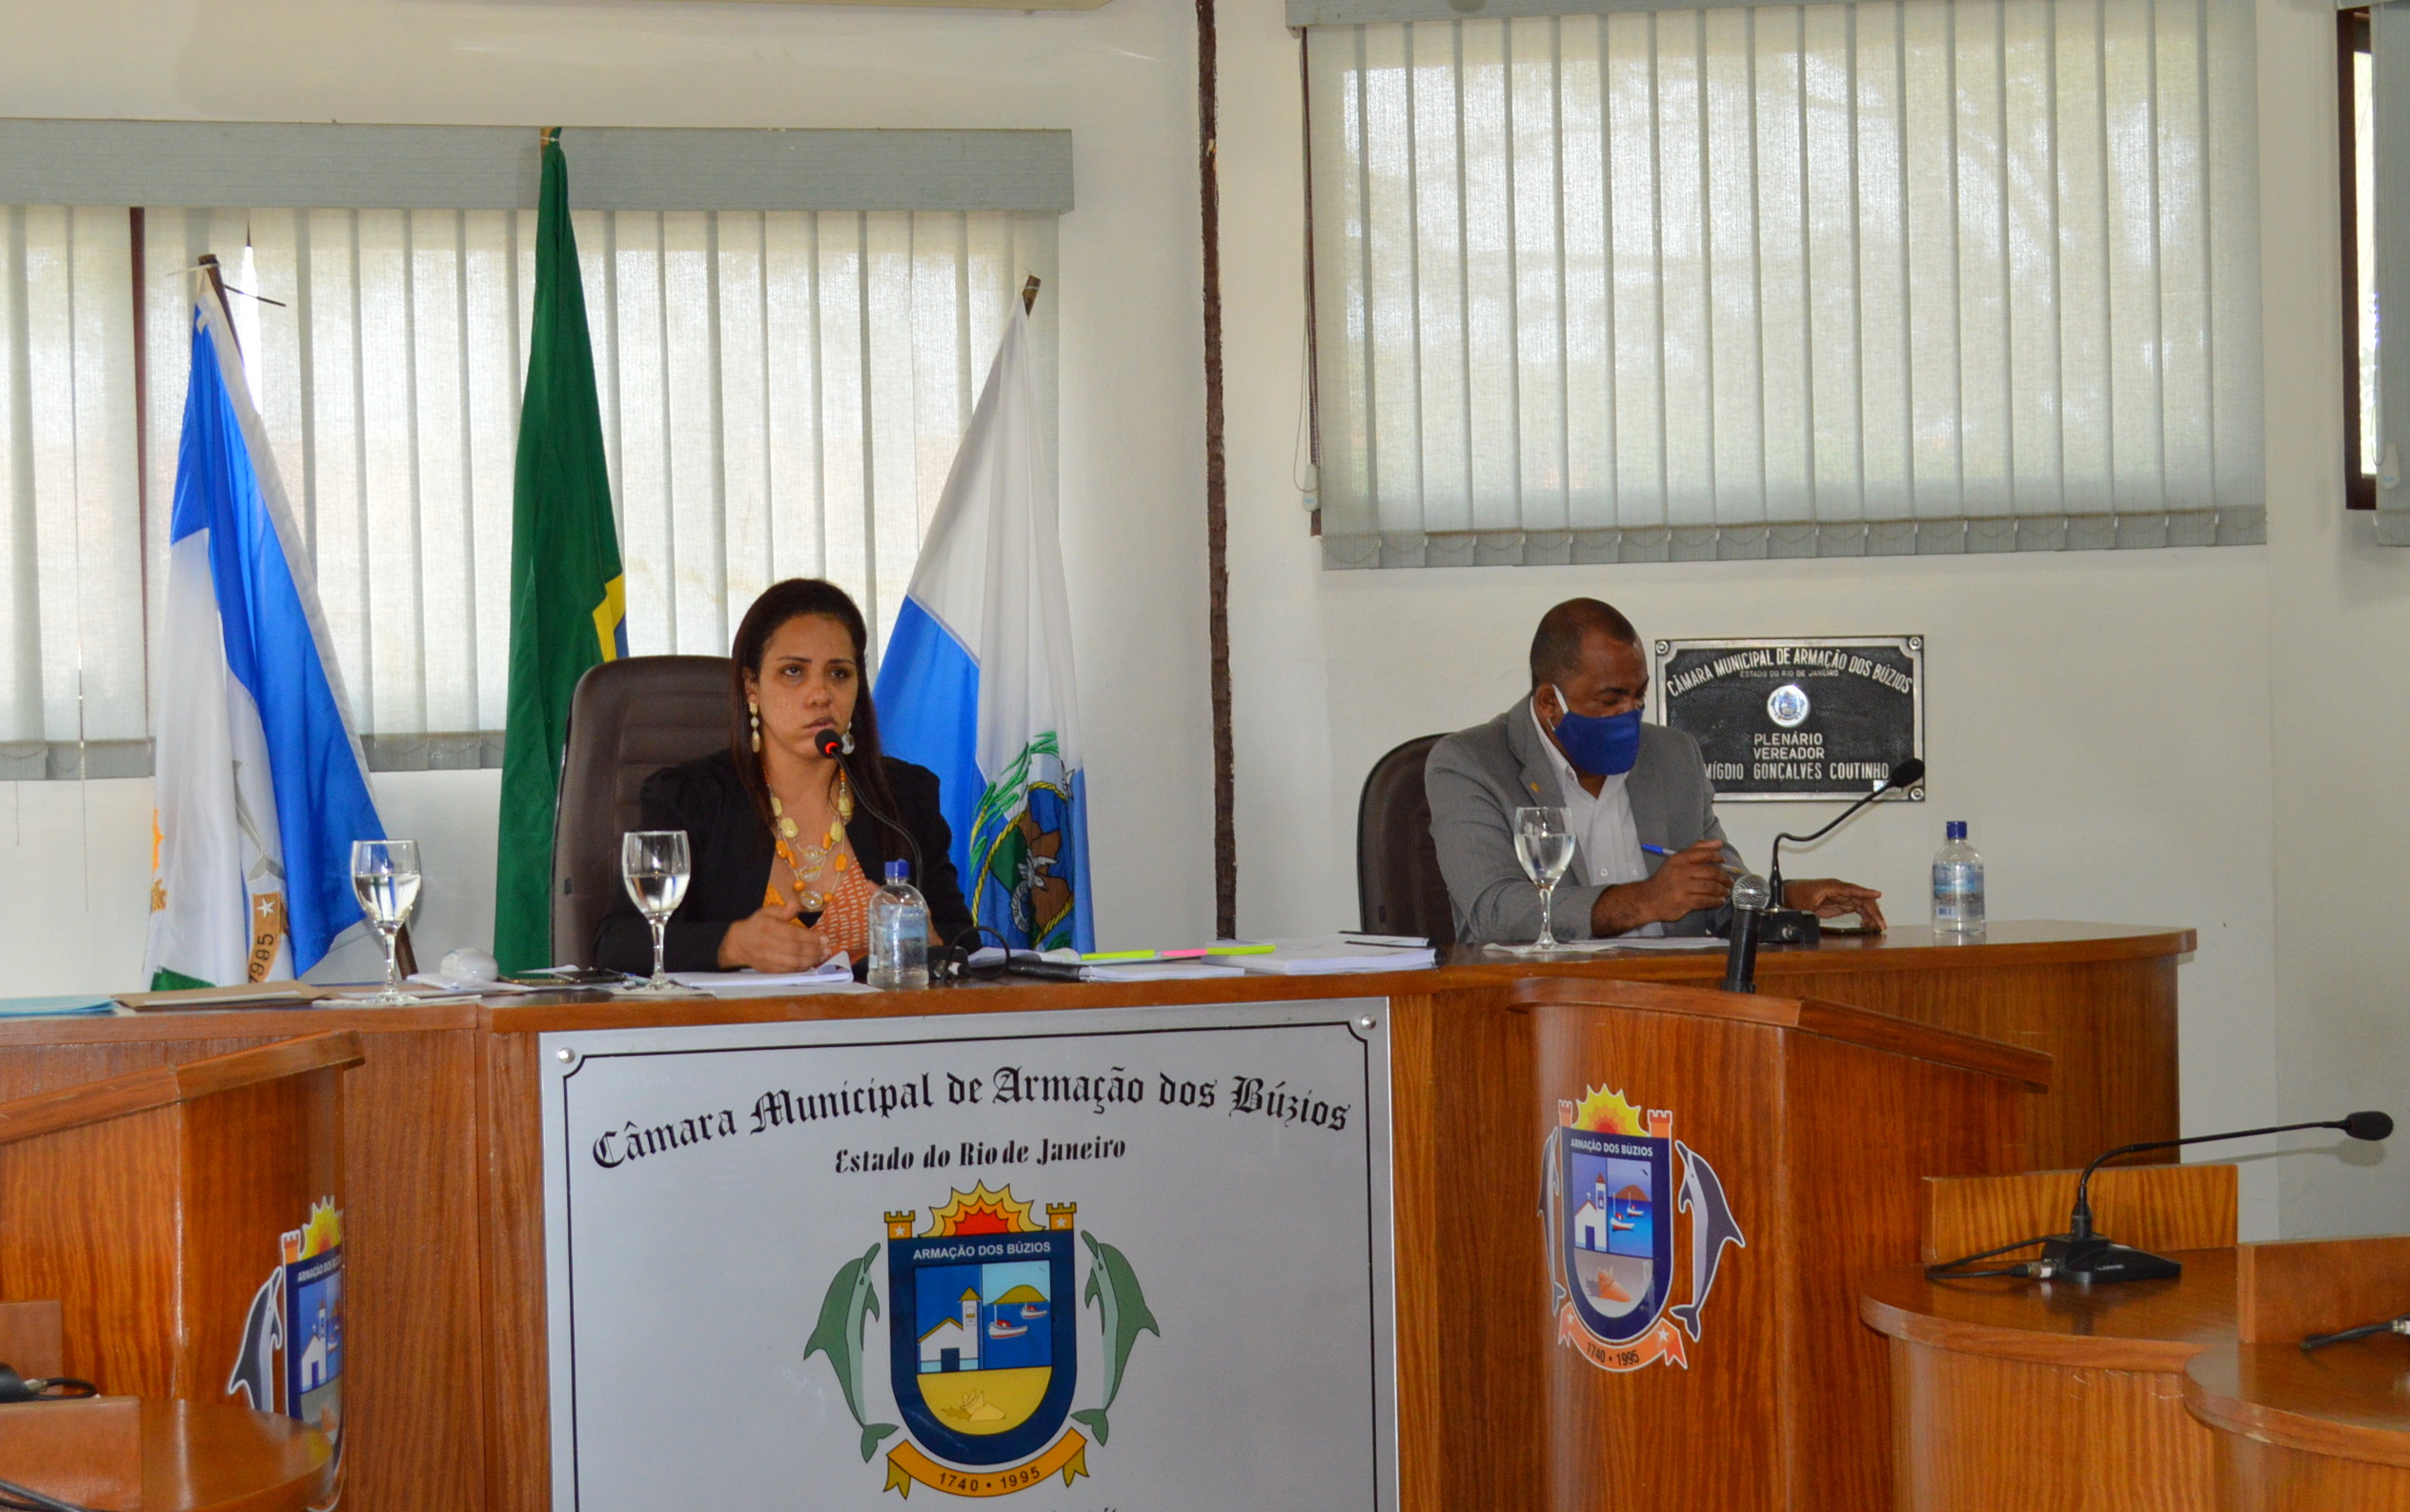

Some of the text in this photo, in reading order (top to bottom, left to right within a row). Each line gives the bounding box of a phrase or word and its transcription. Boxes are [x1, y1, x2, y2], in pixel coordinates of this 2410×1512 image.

[1667, 648, 1913, 696] CÂMARA MUNICIPAL DE ARMAÇÃO DOS BÚZIOS
[1796, 669, 1806, 677] DE
[1809, 669, 1839, 677] JANEIRO
[1753, 731, 1823, 746] PLENÁRIO
[1753, 747, 1825, 759] VEREADOR
[1753, 762, 1823, 781] GONÇALVES
[1830, 762, 1890, 779] COUTINHO
[592, 1065, 1351, 1168] Câmara Municipal de Armação dos Búzios
[835, 1136, 1126, 1174] Estado do Rio de Janeiro
[1570, 1138, 1653, 1157] ARMAÇÃO DOS BÚZIOS
[913, 1241, 1051, 1260] ARMAÇÃO DOS BÚZIOS
[1587, 1342, 1640, 1366] 1740 1995
[939, 1466, 1041, 1492] 1740 1995
